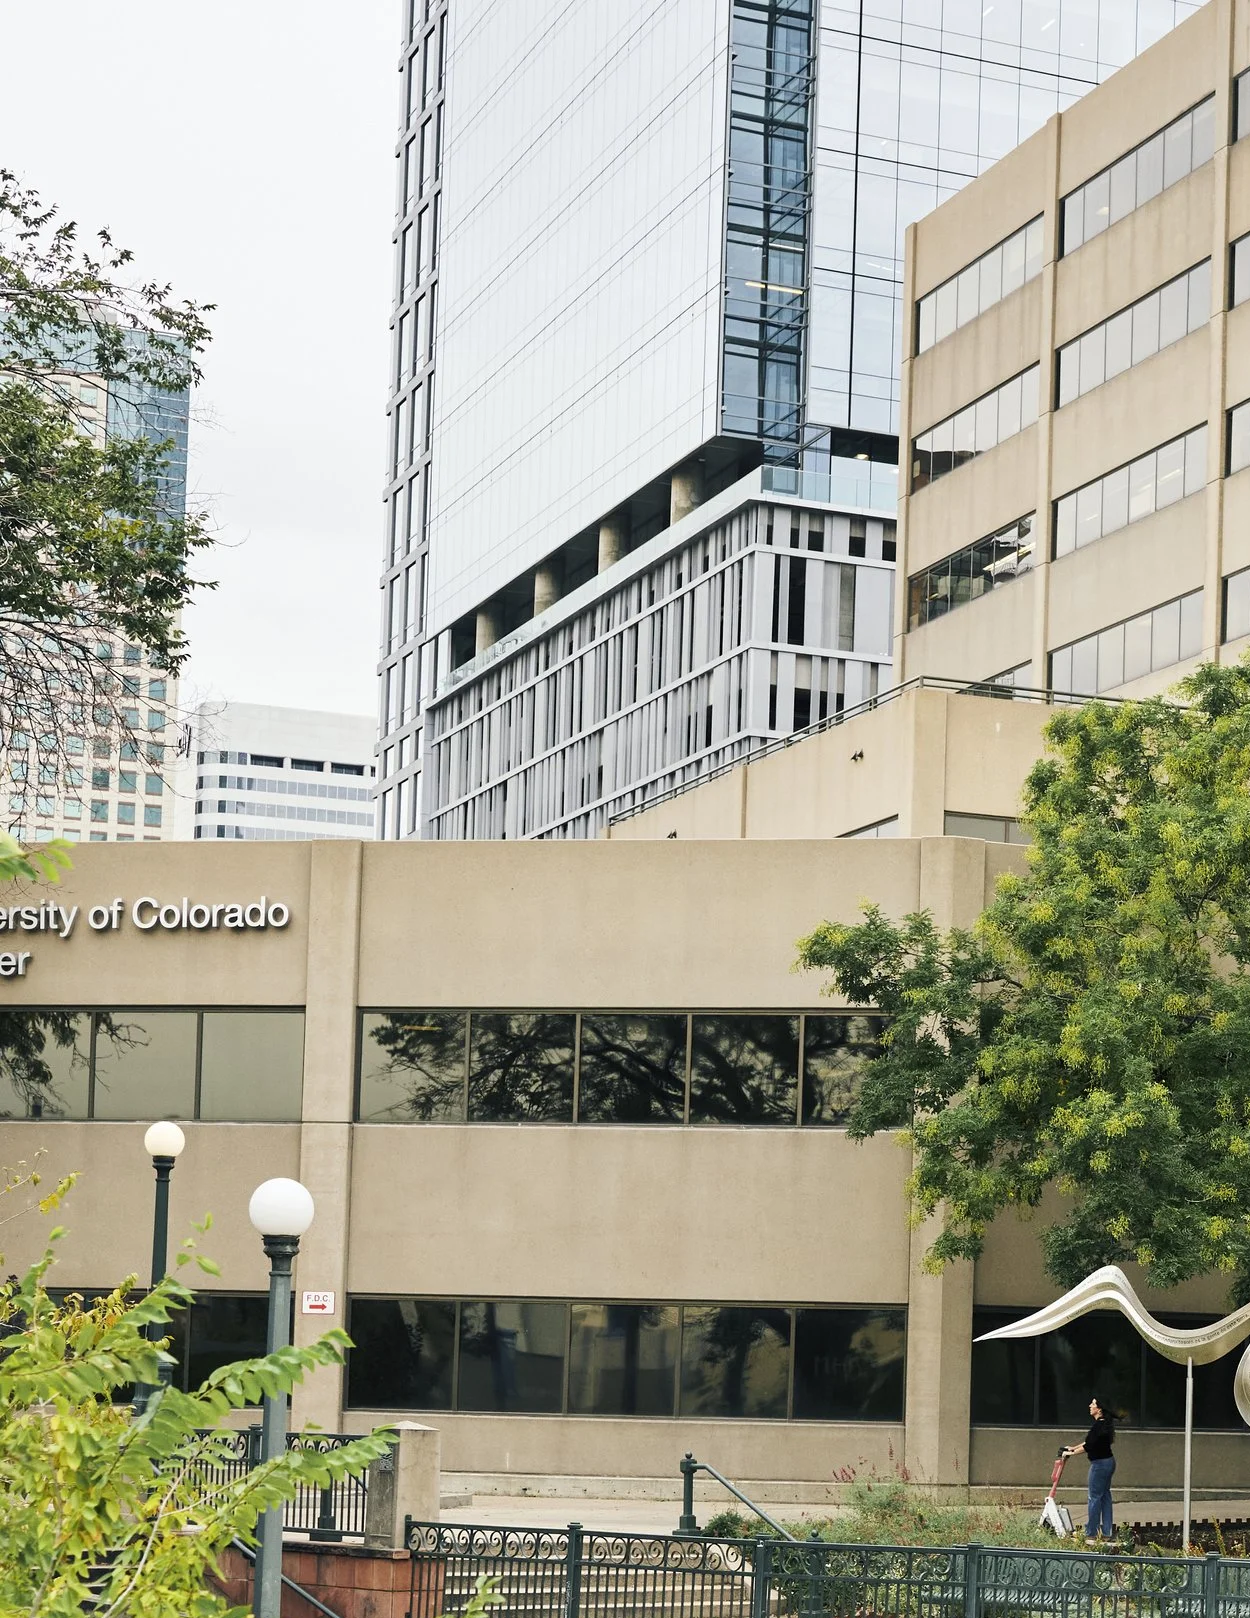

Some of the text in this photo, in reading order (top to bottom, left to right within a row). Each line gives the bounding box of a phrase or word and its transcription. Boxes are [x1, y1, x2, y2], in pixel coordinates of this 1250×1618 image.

[88, 898, 124, 930] of
[132, 896, 290, 930] Colorado
[0, 952, 31, 977] er
